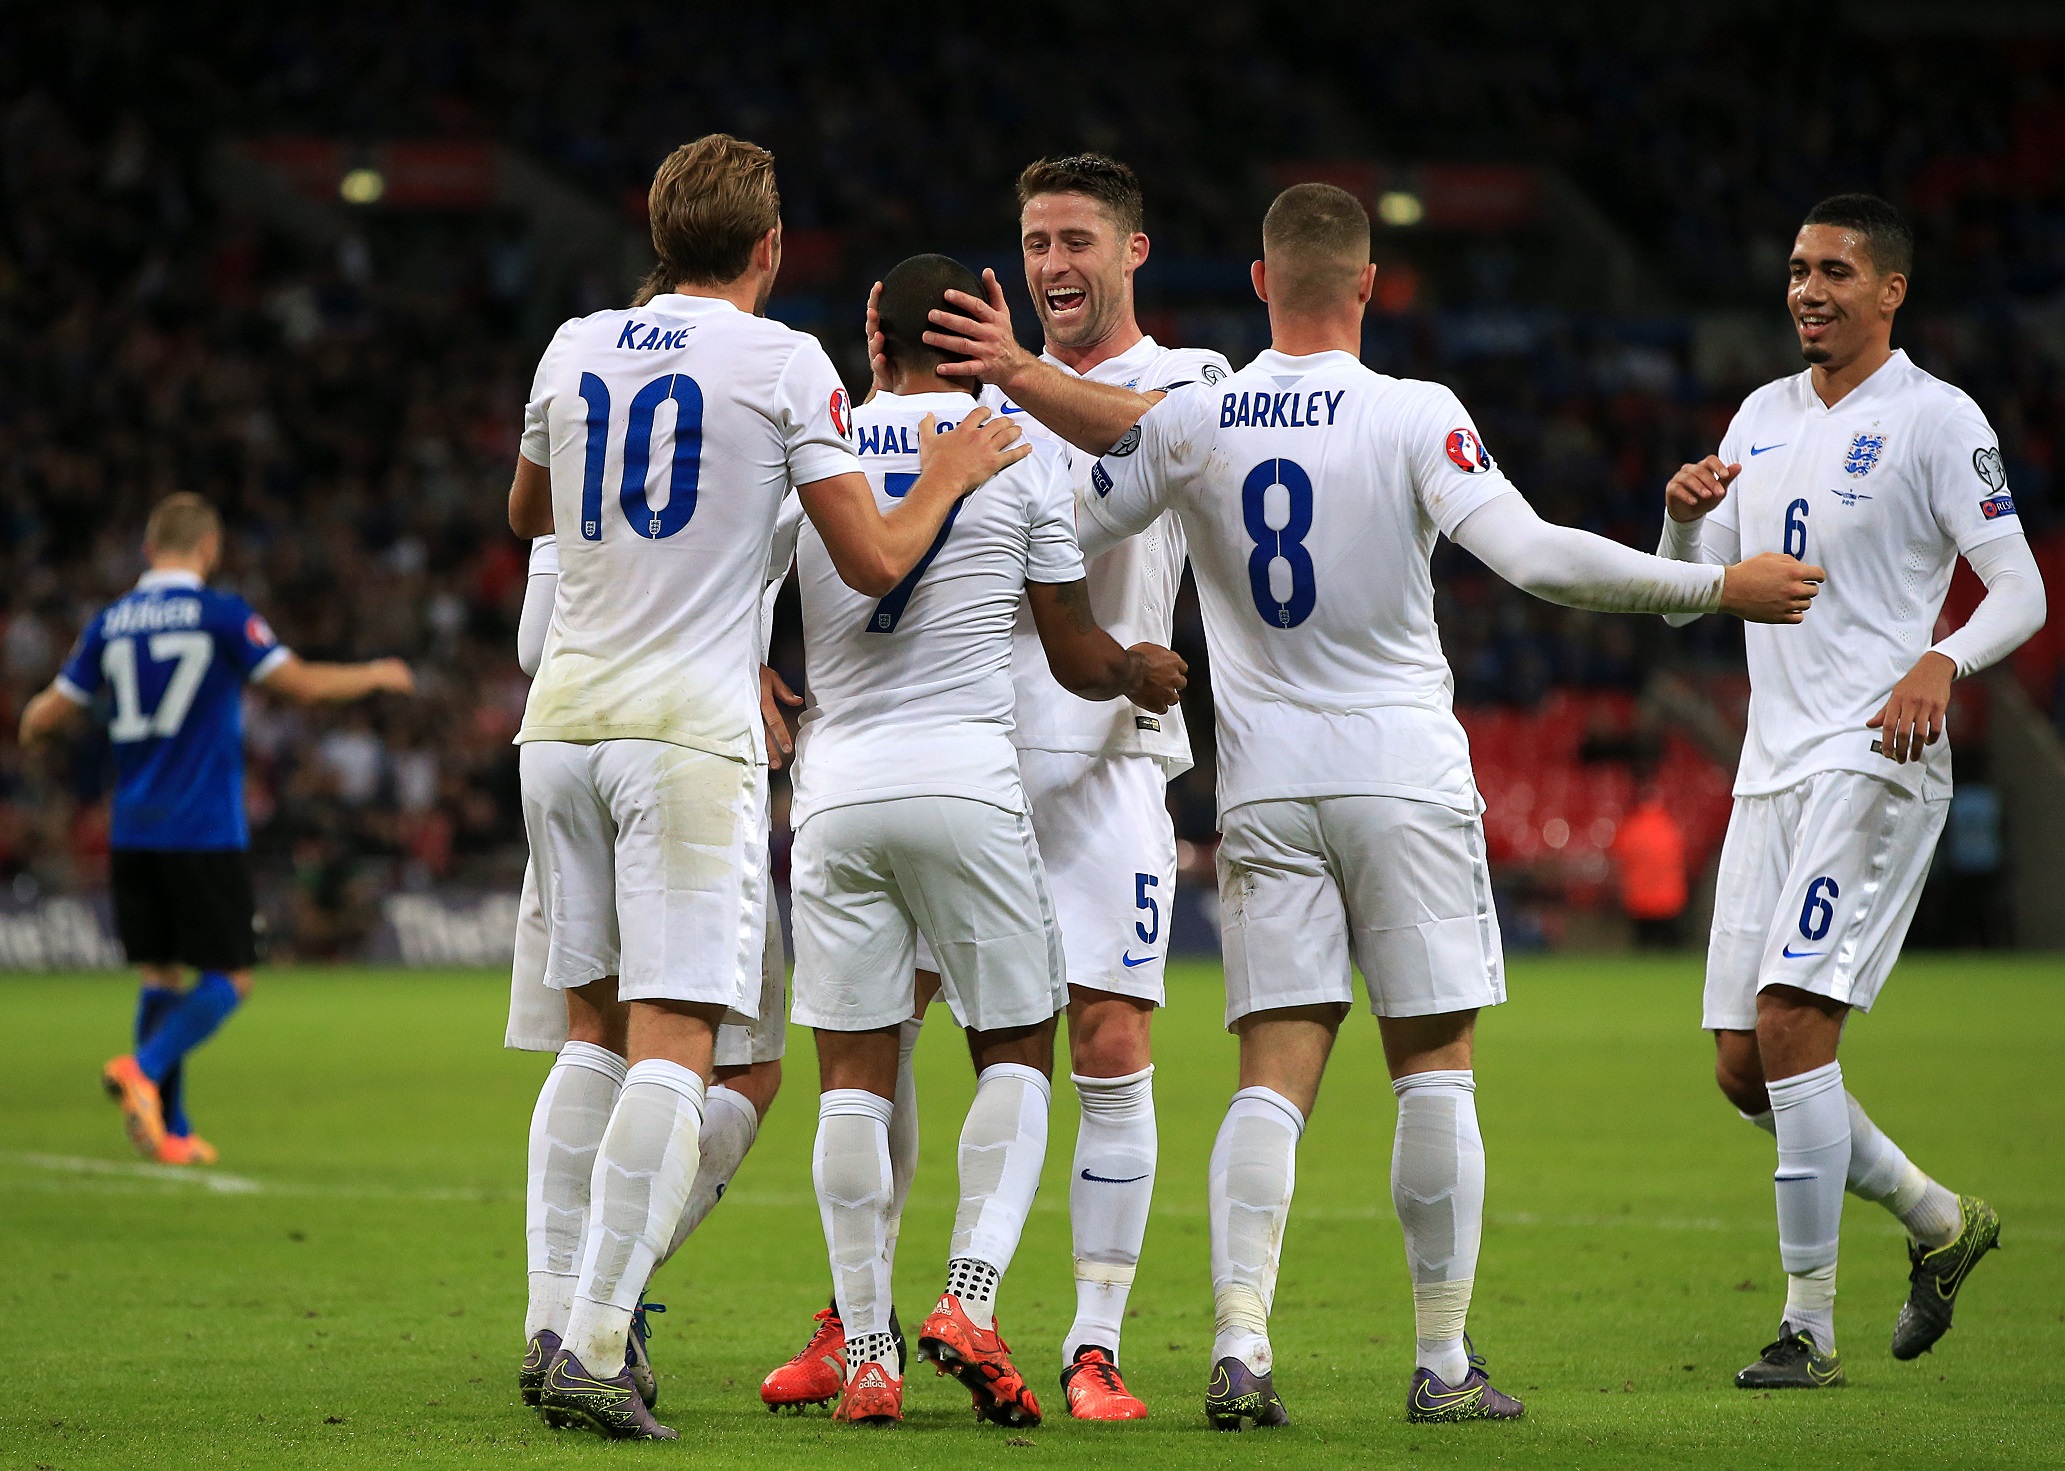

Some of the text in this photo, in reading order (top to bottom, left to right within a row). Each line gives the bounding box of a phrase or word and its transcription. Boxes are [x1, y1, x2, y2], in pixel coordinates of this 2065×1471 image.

[617, 320, 696, 350] KANE
[1220, 390, 1346, 429] BARKLEY
[579, 371, 703, 541] 10
[1242, 458, 1316, 629] 8
[1784, 498, 1809, 561] 6
[102, 632, 214, 742] 17
[1135, 873, 1159, 944] 5
[1799, 876, 1839, 941] 6
[858, 1380, 887, 1389] adidas
